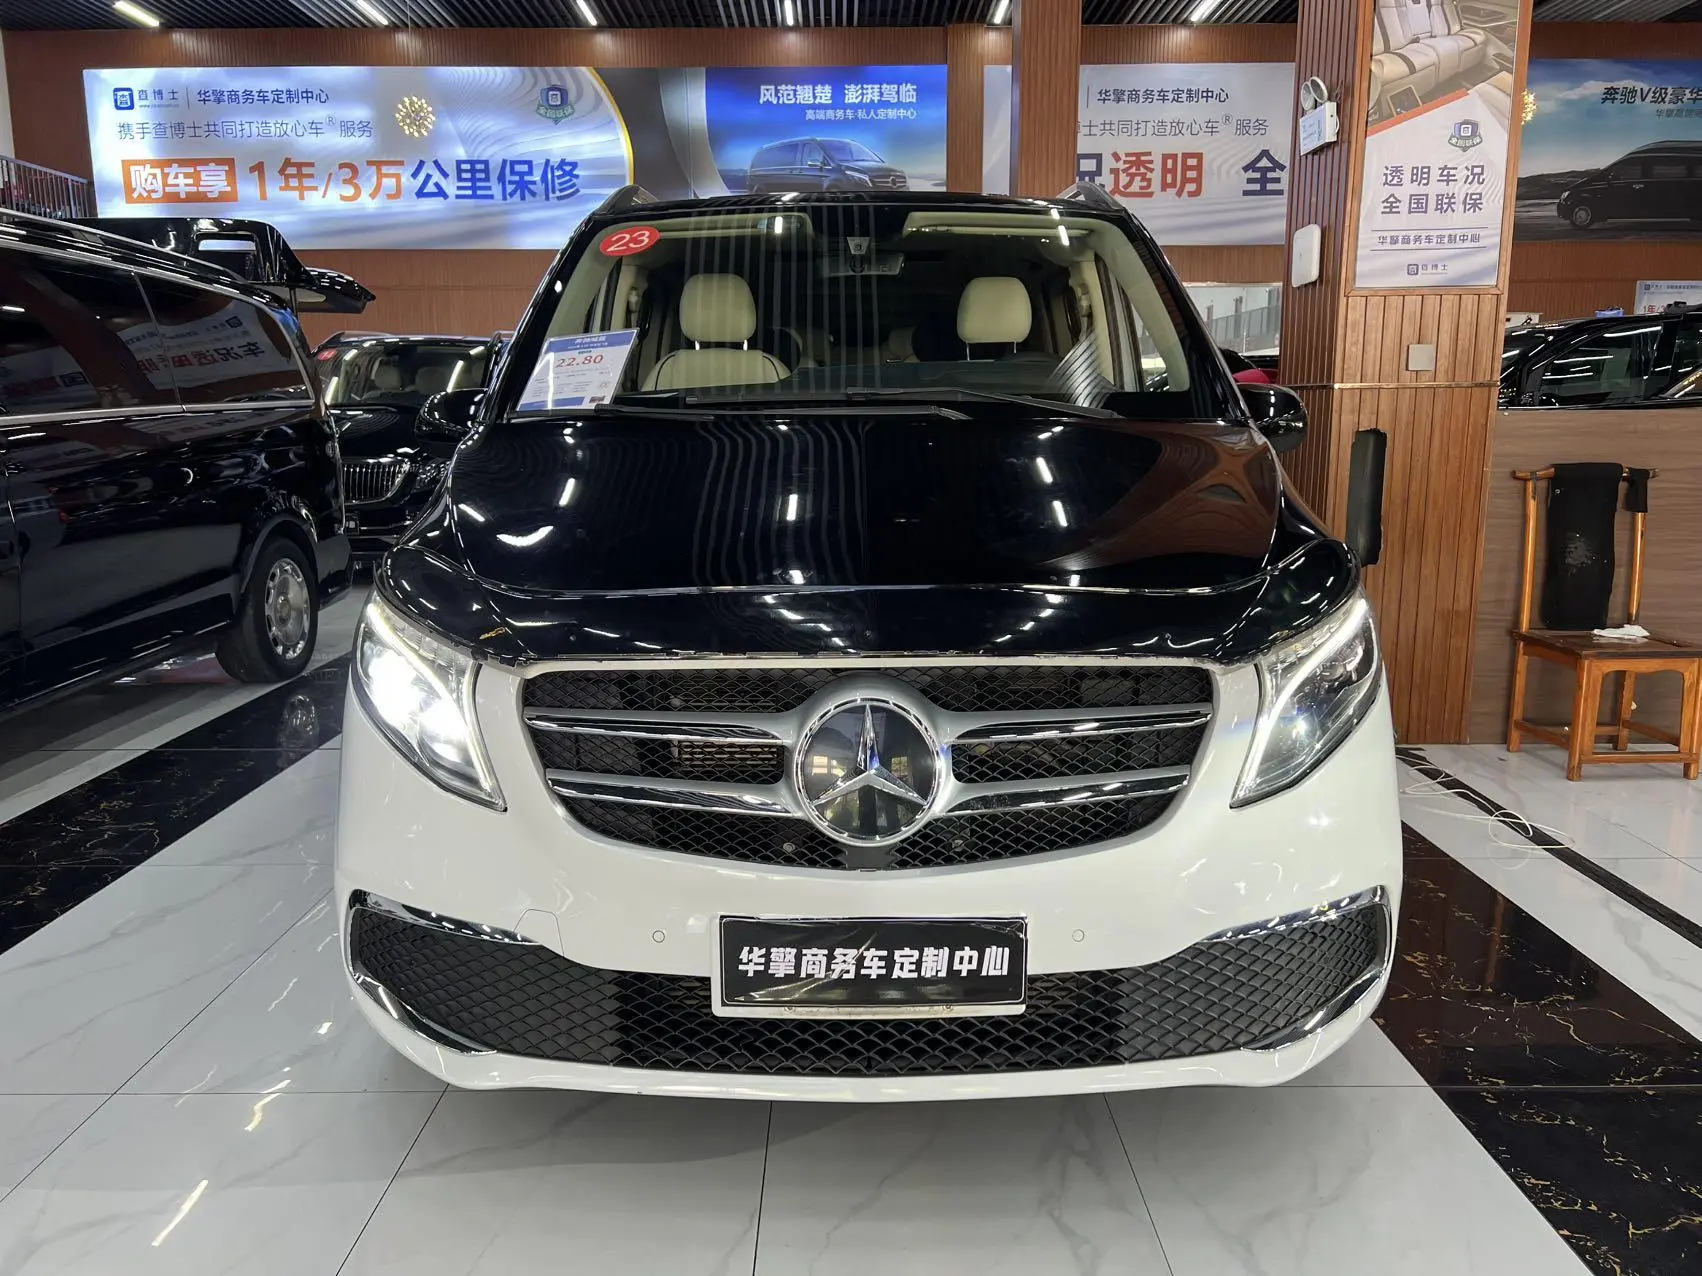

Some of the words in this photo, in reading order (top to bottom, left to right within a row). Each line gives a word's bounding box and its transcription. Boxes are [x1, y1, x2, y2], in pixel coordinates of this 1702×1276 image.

[197, 88, 329, 105] 华擎商务车定制中心
[759, 84, 833, 105] 风范翘楚
[844, 83, 917, 104] 澎湃驾临
[1097, 87, 1229, 105] 华擎商务车定制中心
[130, 161, 232, 199] 购车享
[249, 157, 580, 201] 1年/3万公里保修
[1241, 149, 1287, 197] 全
[1382, 164, 1486, 188] 透明车况
[1380, 191, 1483, 215] 全国联保
[606, 230, 651, 252] 23
[556, 355, 604, 369] 22.80
[738, 945, 1010, 979] 华擎商务车定制中心
